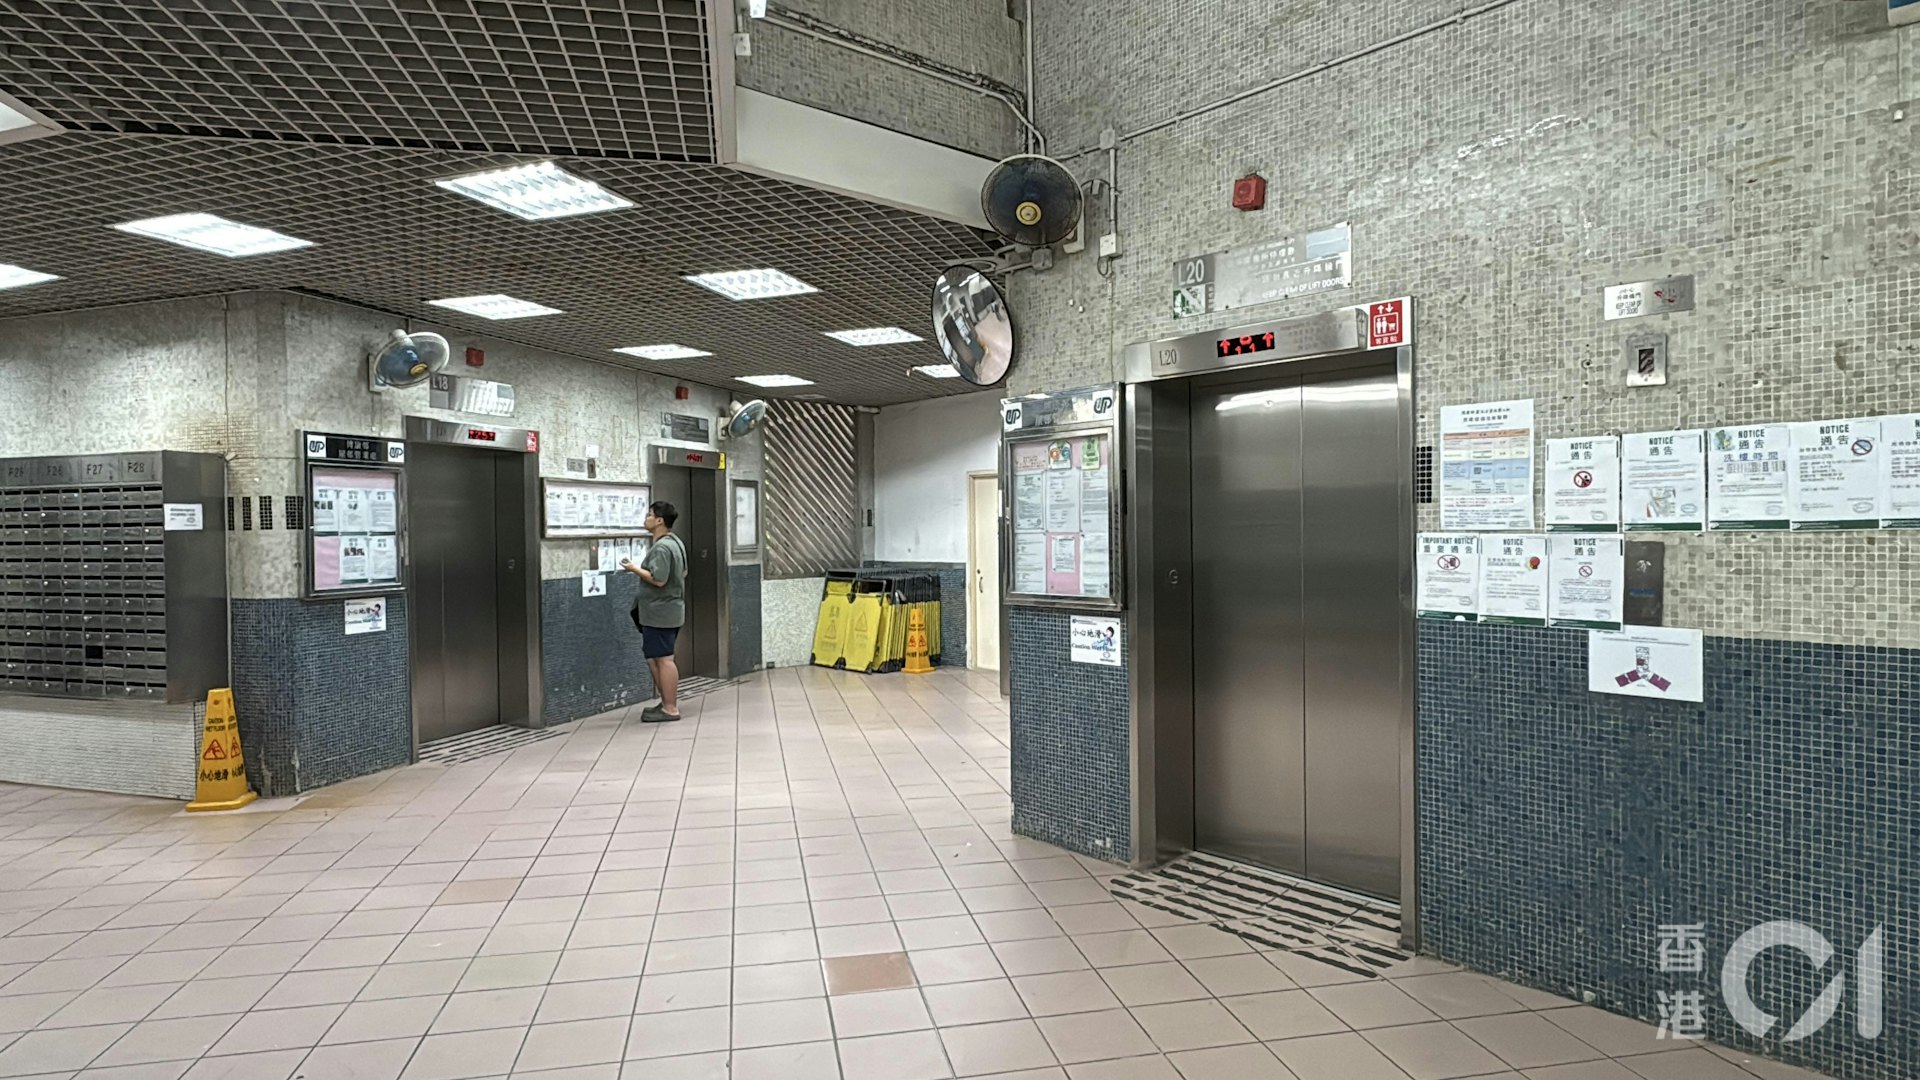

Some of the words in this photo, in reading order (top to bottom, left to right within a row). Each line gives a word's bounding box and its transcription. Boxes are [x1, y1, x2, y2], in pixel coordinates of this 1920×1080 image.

[1178, 259, 1205, 287] L20
[1308, 281, 1321, 292] LIFT
[1321, 277, 1345, 289] DOORS
[1159, 348, 1177, 366] L20
[1738, 429, 1765, 439] NOTICE
[1820, 424, 1849, 435] NOTICE
[1570, 441, 1593, 450] NOTICE
[1649, 436, 1674, 446] NOTICE
[1739, 439, 1764, 450] 通告
[1821, 435, 1848, 447] 通告
[1571, 451, 1592, 460] 通告
[1649, 446, 1674, 457] 通告
[86, 463, 102, 475] F27
[127, 461, 145, 474] F28
[1422, 537, 1453, 545] IMPORTANT
[1454, 537, 1474, 545] NOTICE
[1503, 538, 1523, 546] NOTICE
[1573, 538, 1596, 547] NOTICE
[1503, 547, 1523, 556] 通告
[1574, 547, 1596, 556] 通告
